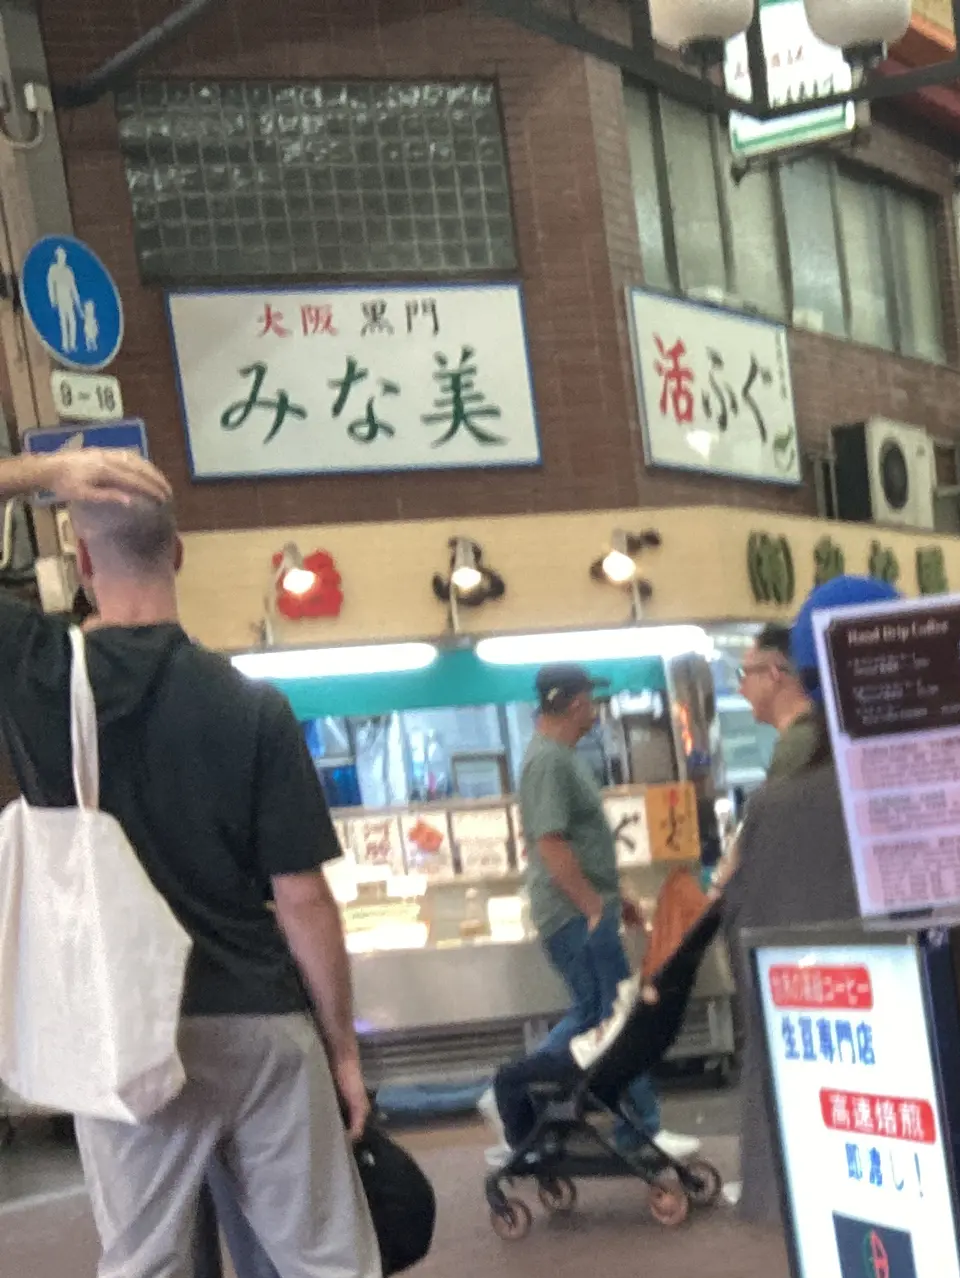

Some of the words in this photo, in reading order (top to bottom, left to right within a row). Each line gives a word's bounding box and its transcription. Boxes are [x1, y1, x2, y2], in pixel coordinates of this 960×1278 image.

[257, 303, 338, 337] 大阪
[360, 298, 439, 337] 黒門
[220, 345, 506, 449] みな美
[653, 332, 773, 443] 活ふぐ
[781, 1015, 875, 1066] 生豆専門店
[829, 1093, 925, 1140] 高速焙煎
